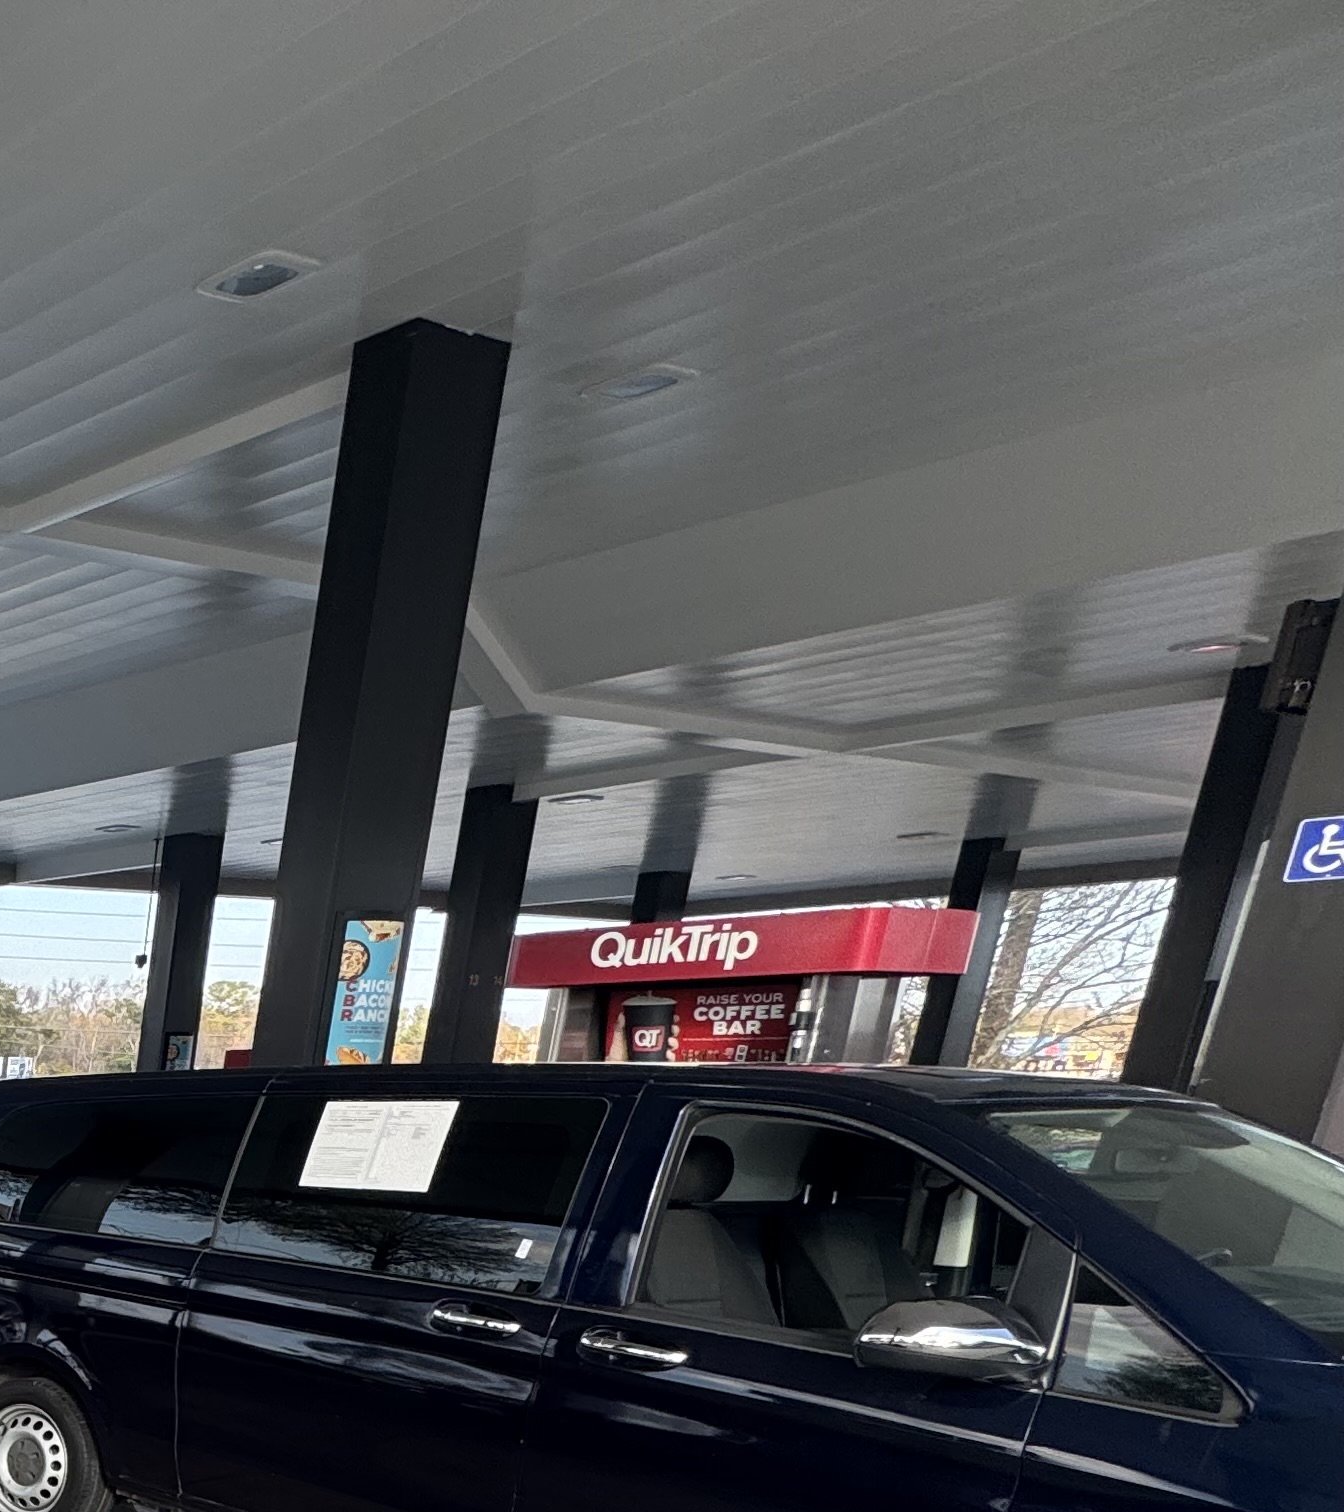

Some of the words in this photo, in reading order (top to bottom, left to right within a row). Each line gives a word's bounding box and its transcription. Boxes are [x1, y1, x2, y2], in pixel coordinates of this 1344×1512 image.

[590, 923, 758, 971] QuikTrip
[696, 994, 739, 1005] RAISE
[743, 992, 784, 1004] YOUR
[693, 1003, 786, 1021] COFFEE
[712, 1020, 762, 1036] BAR
[633, 1028, 661, 1048] QT
